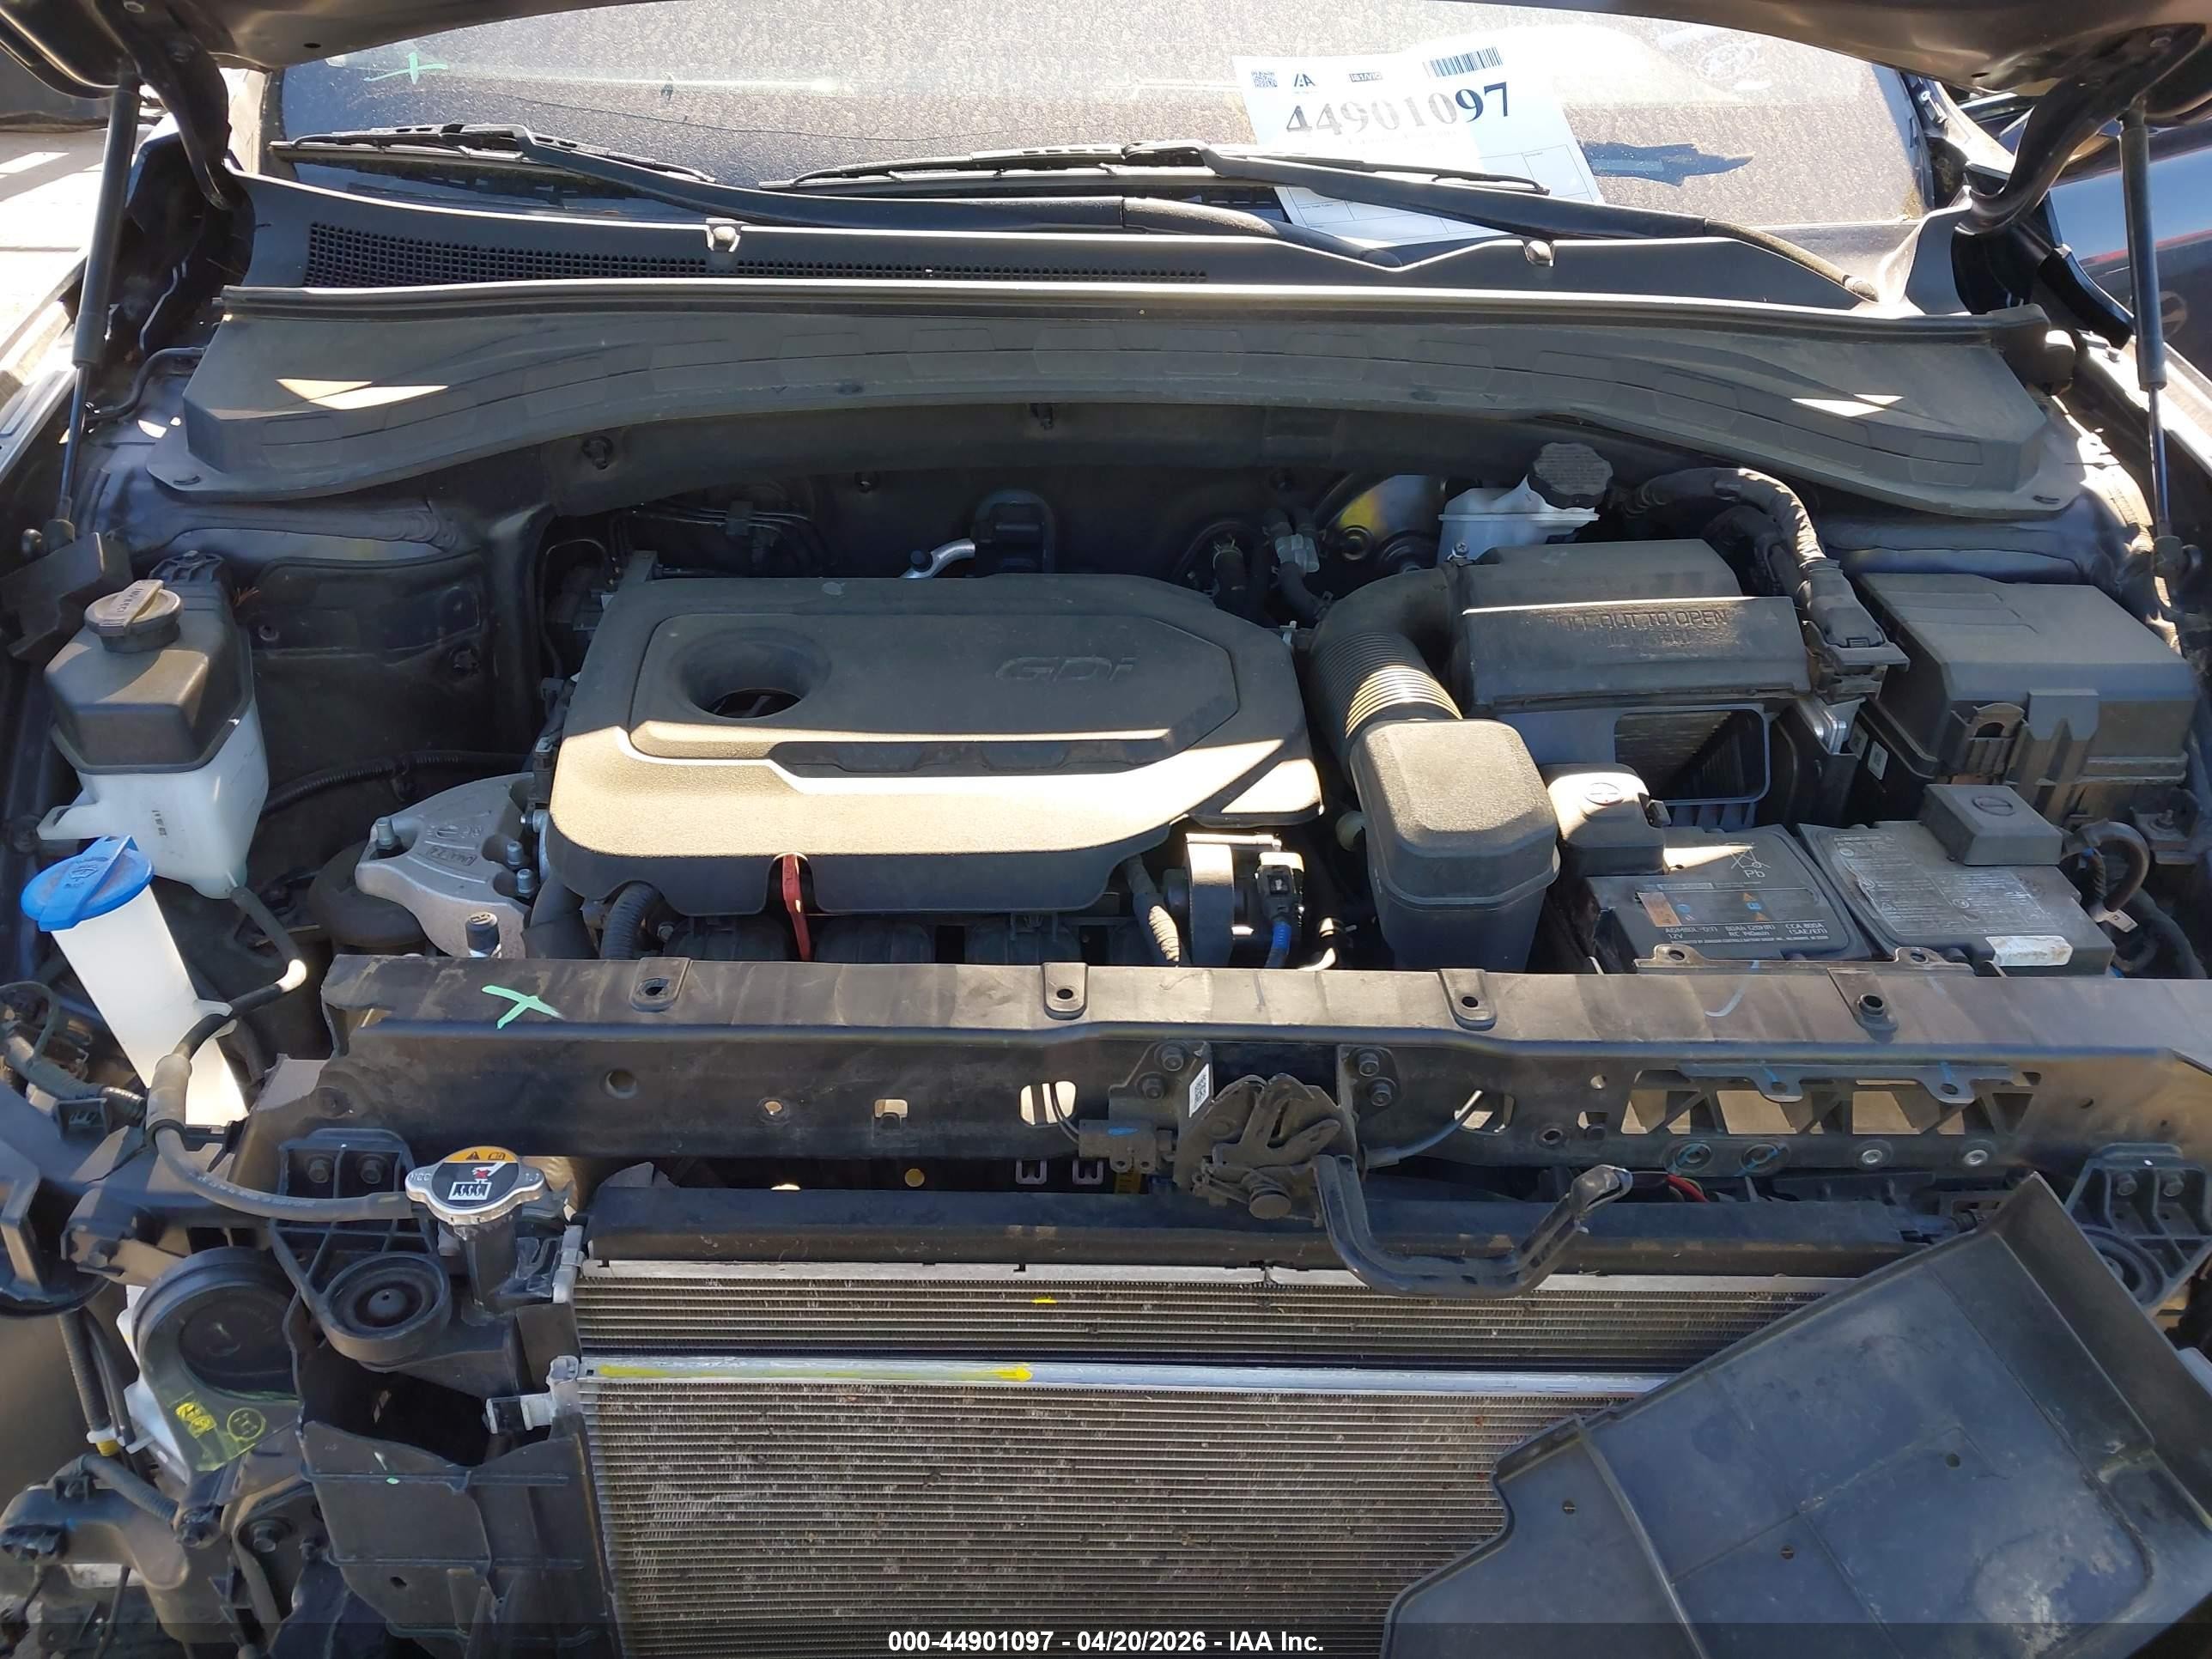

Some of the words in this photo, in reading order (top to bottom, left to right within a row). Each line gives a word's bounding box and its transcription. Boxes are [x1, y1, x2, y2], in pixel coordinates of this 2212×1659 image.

[1285, 82, 1510, 137] 44901097
[1599, 612, 1637, 629] OUT
[1645, 611, 1670, 628] TO
[1675, 608, 1728, 627] OPEN
[1743, 869, 1765, 878] Pb
